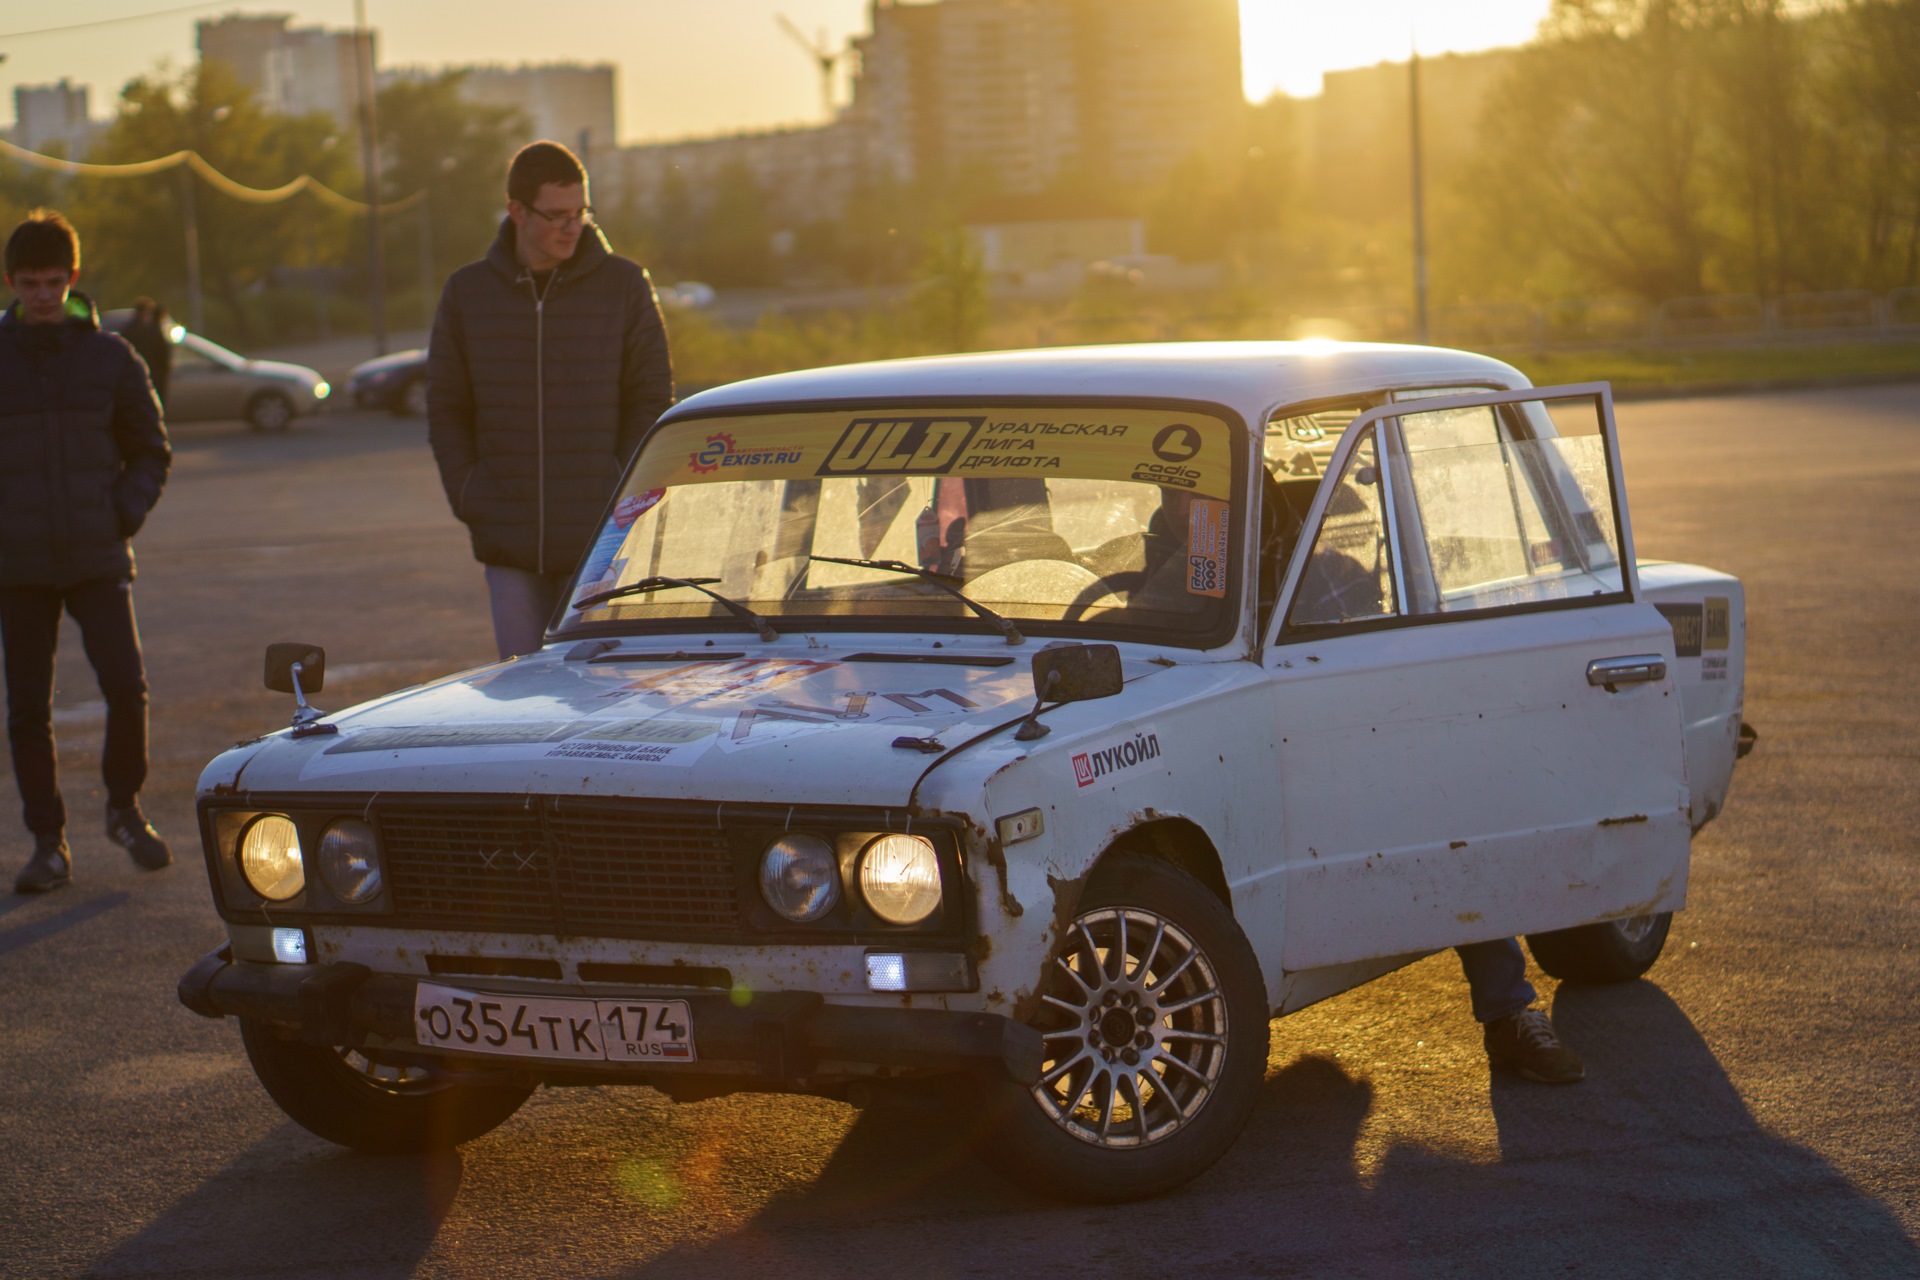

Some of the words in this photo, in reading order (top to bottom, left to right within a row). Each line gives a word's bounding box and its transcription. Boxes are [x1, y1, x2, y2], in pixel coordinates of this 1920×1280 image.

[986, 422, 1129, 437] УРАЛЬСКАЯ
[972, 438, 1035, 450] ЛИГА
[720, 451, 802, 467] EXIST.RU
[958, 455, 1061, 470] ДРИФТА
[1134, 462, 1202, 479] radio
[1217, 508, 1229, 590] www.dak4x4.com
[1092, 733, 1160, 778] ЛУКОЙЛ
[606, 1005, 679, 1041] 174
[626, 1042, 662, 1056] RUS
